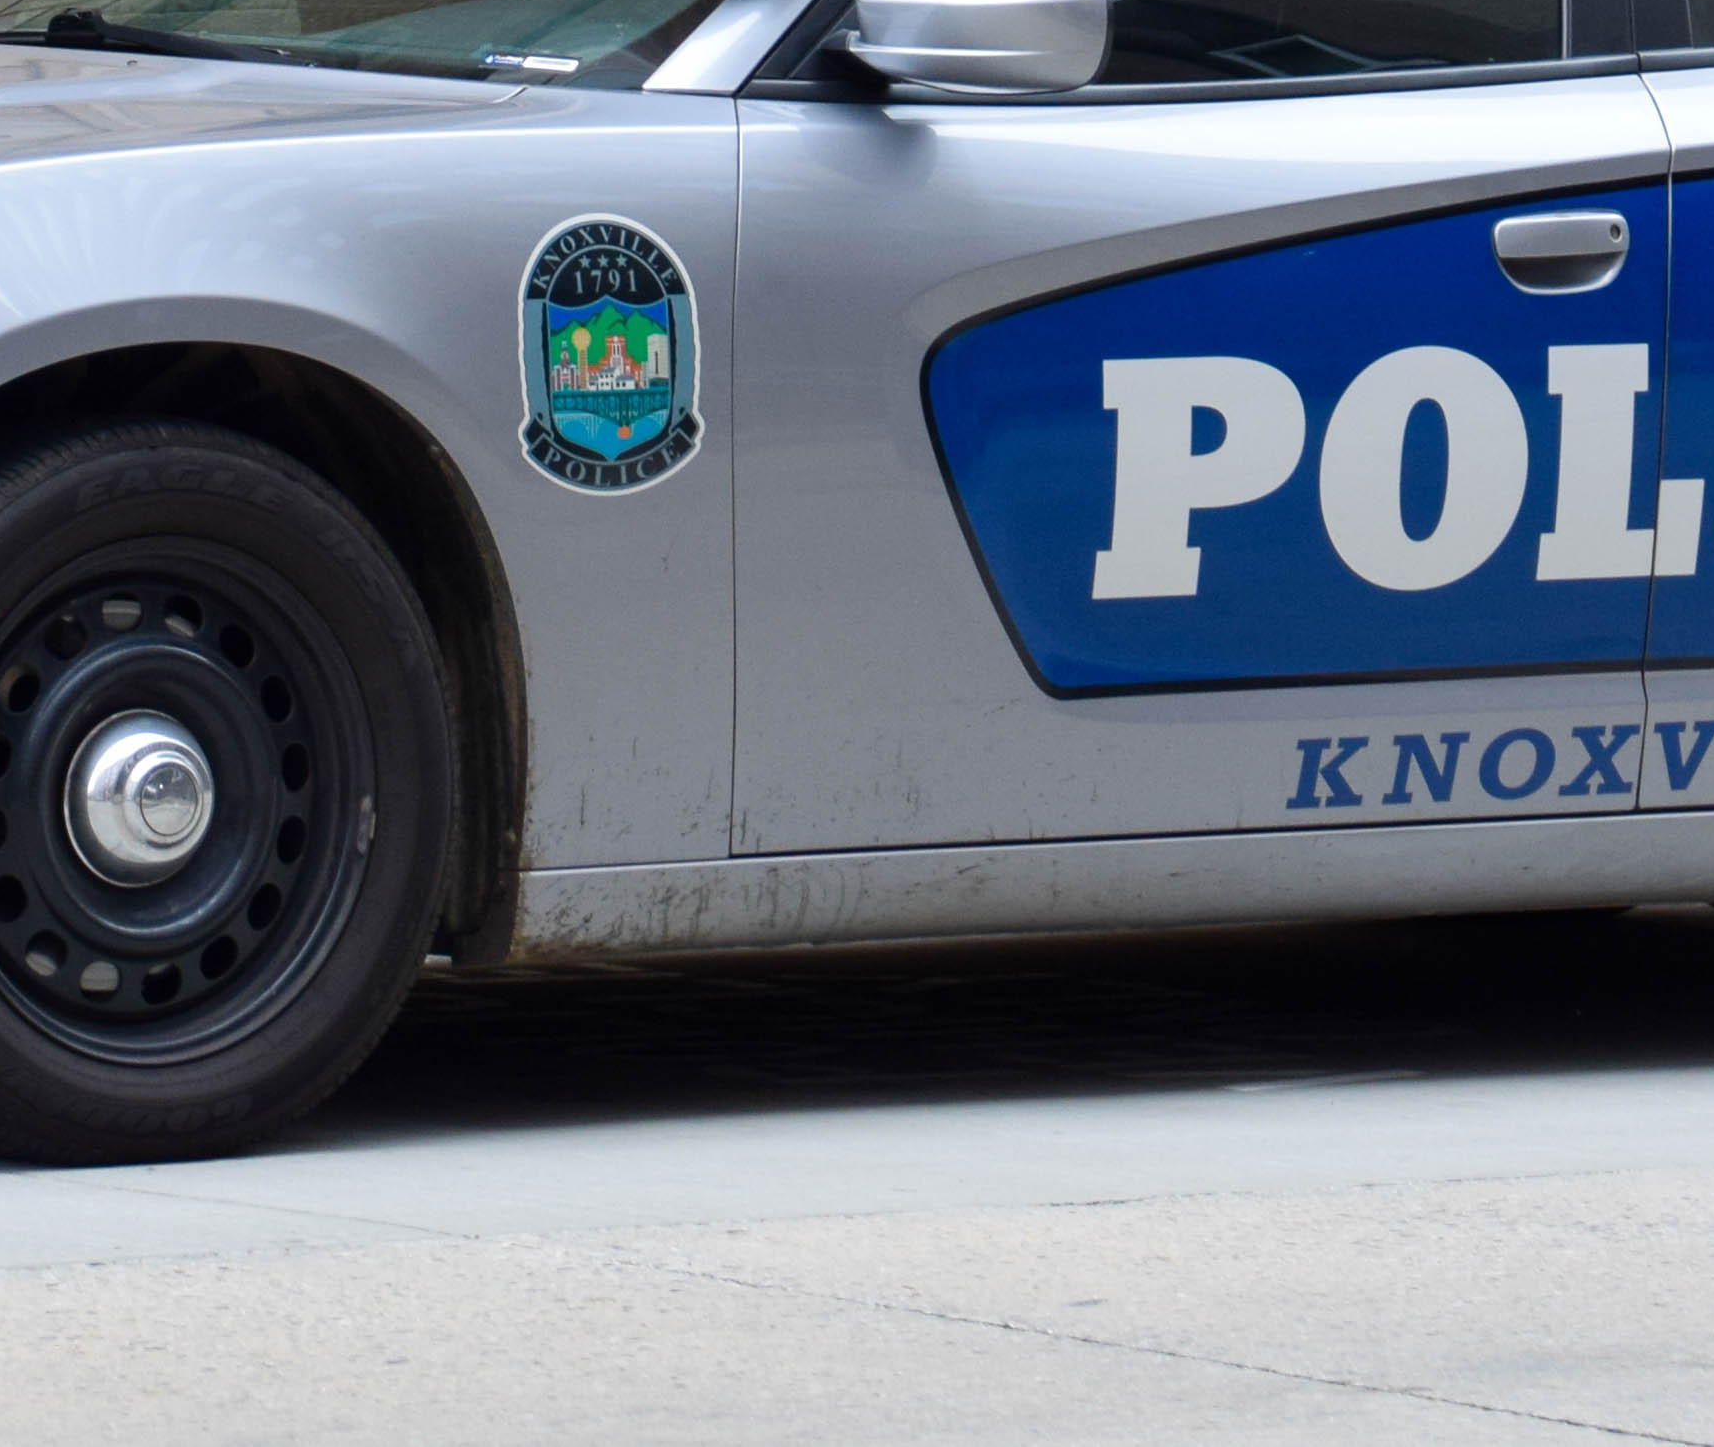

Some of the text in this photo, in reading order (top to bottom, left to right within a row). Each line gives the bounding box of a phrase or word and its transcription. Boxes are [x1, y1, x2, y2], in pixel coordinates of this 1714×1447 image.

[532, 225, 680, 290] KNOXVILLE
[574, 269, 638, 294] 1791
[542, 439, 683, 487] POLICE
